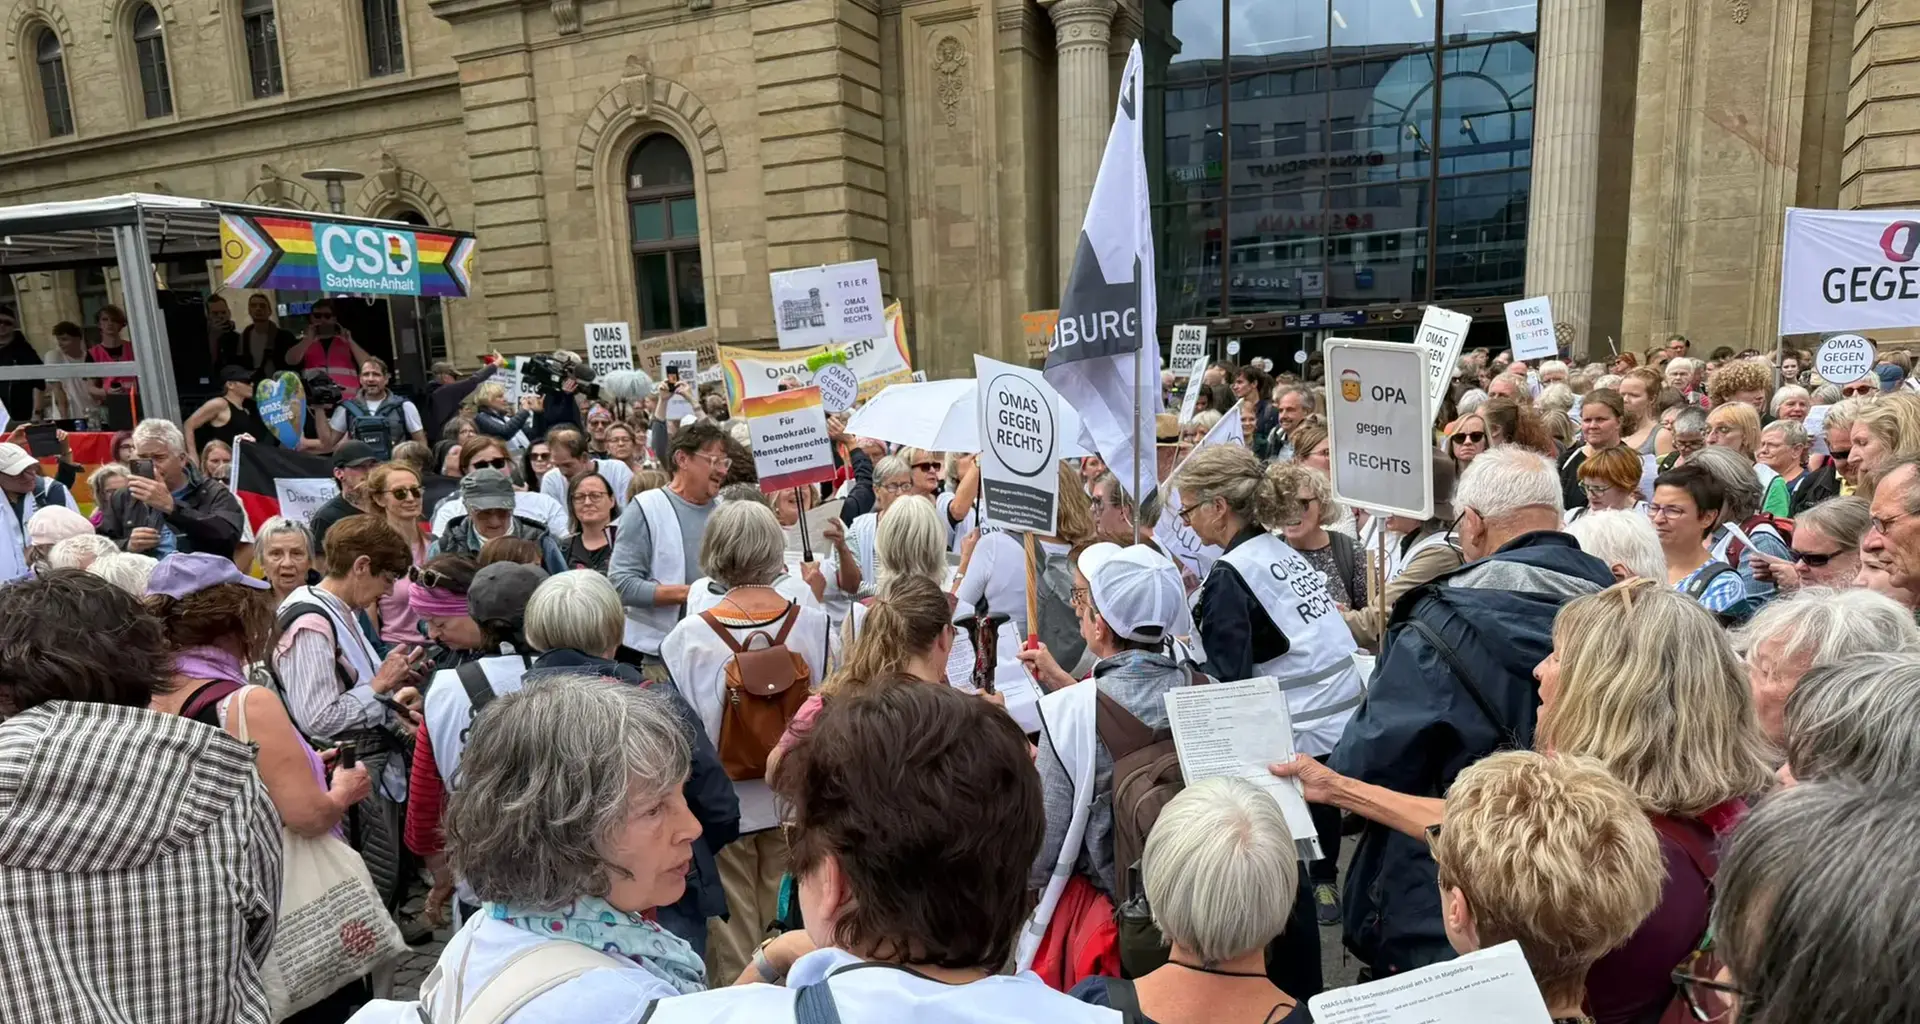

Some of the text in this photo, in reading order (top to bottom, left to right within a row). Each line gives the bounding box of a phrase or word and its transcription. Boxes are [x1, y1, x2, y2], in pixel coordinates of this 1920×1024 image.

[321, 225, 412, 276] CSD
[326, 273, 415, 291] Sachsen-Anhalt
[837, 278, 868, 289] TRIER
[1822, 266, 1920, 304] GEGE
[844, 297, 866, 306] OMAS
[843, 305, 869, 315] GEGEN
[1514, 306, 1540, 317] OMAS
[843, 314, 873, 324] RECHTS
[593, 327, 622, 342] OMAS
[1178, 329, 1201, 341] OMAS
[1425, 331, 1449, 348] OMAS
[592, 344, 627, 359] GEGEN
[1175, 343, 1201, 355] GEGEN
[1827, 339, 1864, 350] OMAS
[1172, 357, 1197, 370] RECHT
[1823, 352, 1864, 362] GEGEN
[766, 363, 808, 379] OMA
[828, 365, 855, 388] OMAS
[1821, 364, 1866, 375] RECHTS
[820, 374, 850, 400] GEGEN
[820, 388, 846, 411] ECHTS
[999, 391, 1038, 414] OMAS
[1371, 385, 1407, 405] OPA
[260, 400, 281, 415] omas
[269, 410, 294, 425] future
[779, 417, 795, 426] Für
[999, 409, 1041, 434] GEGEN
[762, 426, 816, 443] Demokratie
[1355, 421, 1393, 436] gegen
[753, 436, 829, 458] Menschenrechte
[997, 428, 1043, 454] RECHTS
[774, 454, 814, 467] Toleranz
[1348, 452, 1411, 475] RECHTS
[286, 488, 316, 503] Diese
[1290, 572, 1323, 598] GEGE
[1296, 591, 1335, 624] RECH
[1441, 965, 1474, 977] Magdeburg
